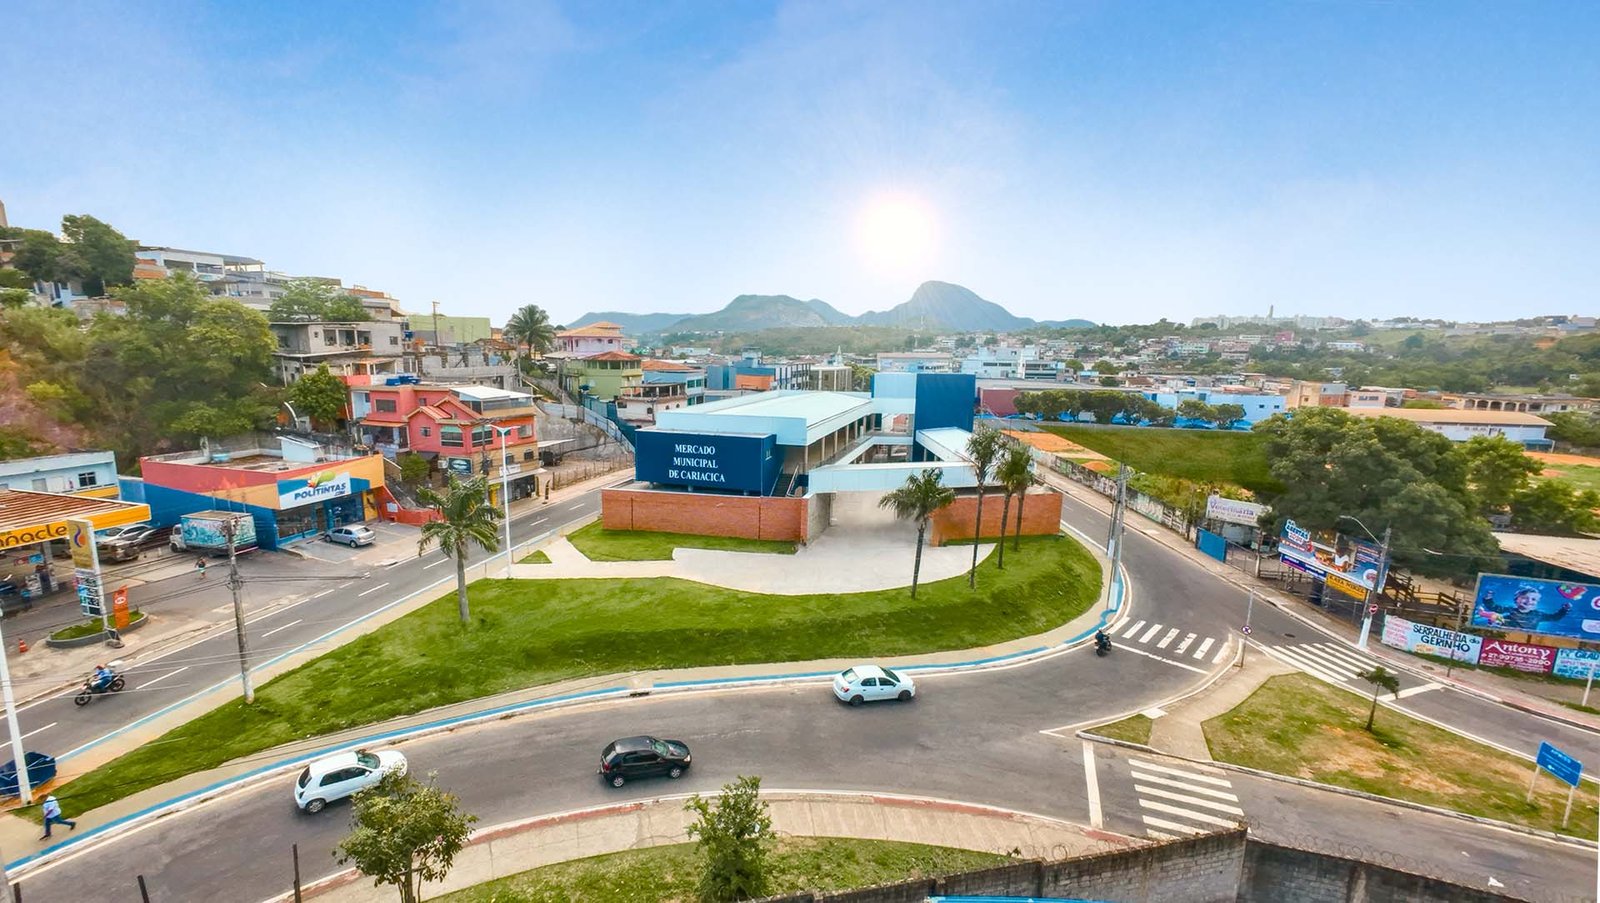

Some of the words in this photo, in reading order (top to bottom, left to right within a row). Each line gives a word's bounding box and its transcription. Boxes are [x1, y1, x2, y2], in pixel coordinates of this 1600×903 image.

[675, 443, 716, 455] MERCADO
[673, 457, 719, 469] MUNICIPAL
[668, 469, 680, 479] DE
[680, 470, 726, 482] CARIACICA
[294, 483, 346, 500] POLITINTAS
[0, 524, 68, 547] nacle
[1420, 635, 1470, 652] GERINHO
[1485, 641, 1550, 660] Antony
